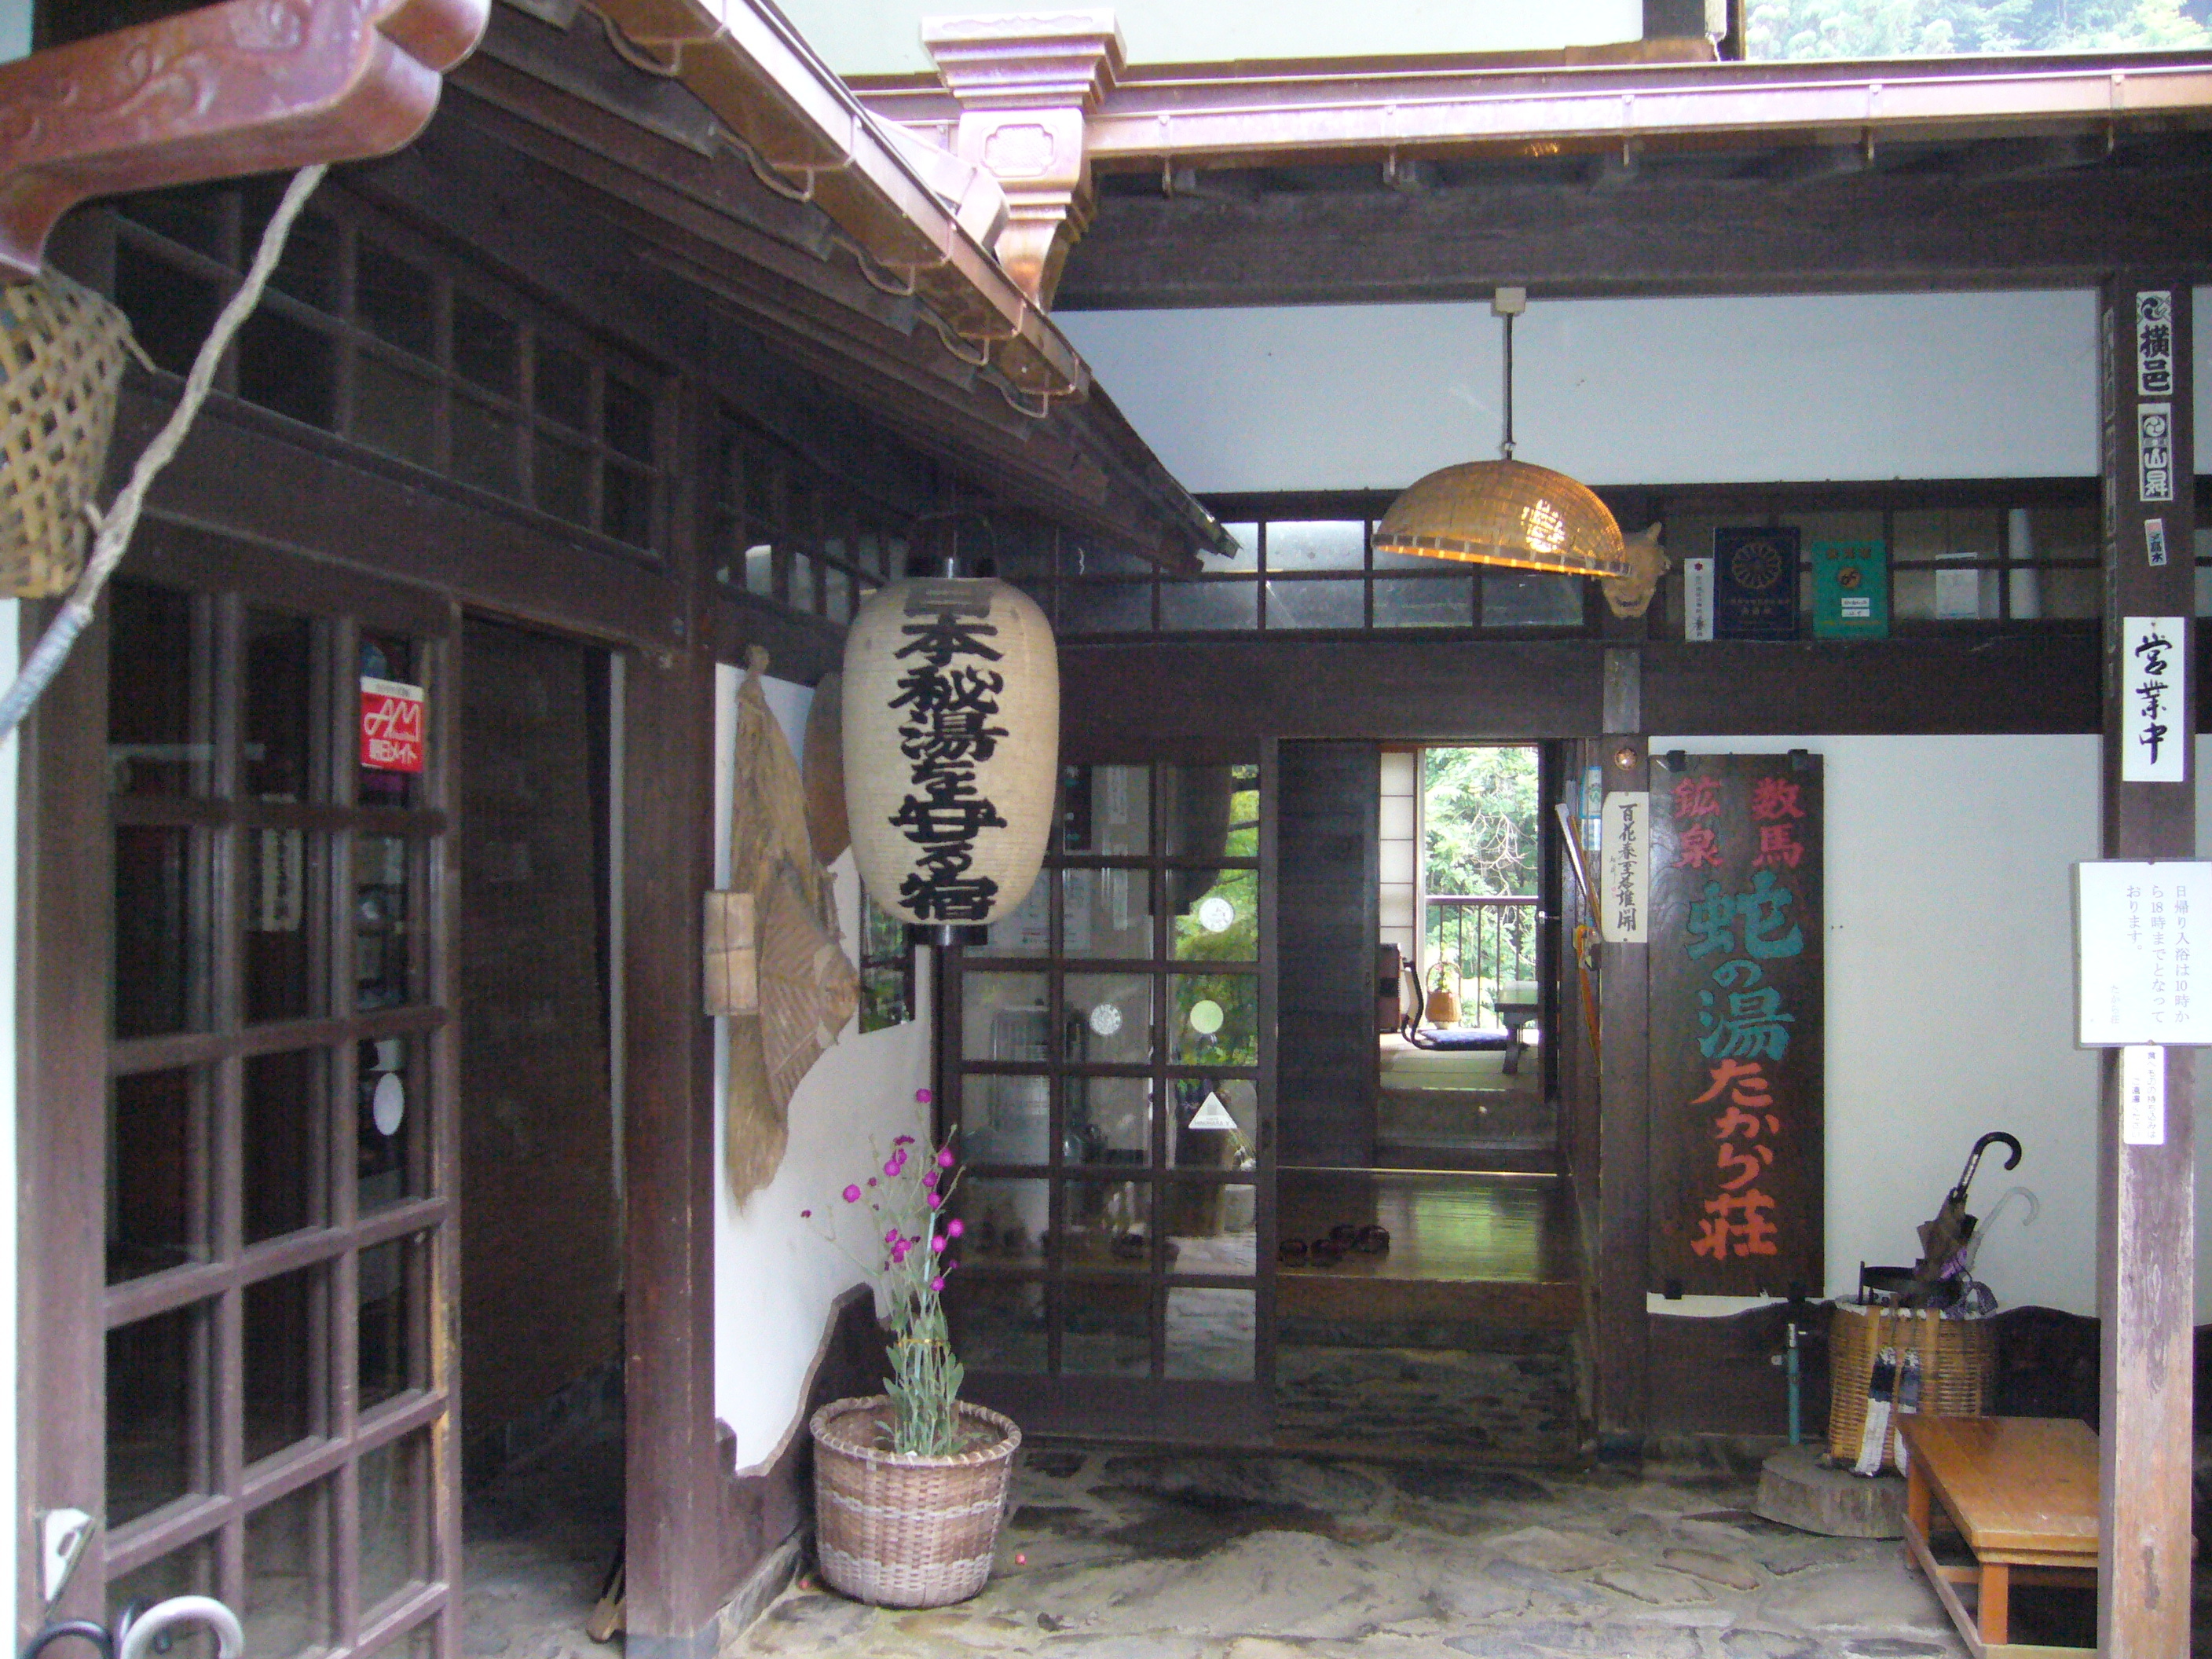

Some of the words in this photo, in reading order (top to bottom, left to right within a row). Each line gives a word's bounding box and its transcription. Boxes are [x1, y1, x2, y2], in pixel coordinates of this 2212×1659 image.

[2134, 632, 2173, 765] 営業中
[1672, 775, 1724, 869] 鉱泉
[1751, 777, 1805, 868] 数馬
[2126, 884, 2143, 950] おります。
[2151, 884, 2166, 1024] ら18時までとなって
[2174, 885, 2190, 1024] 日帰り入浴は10時か
